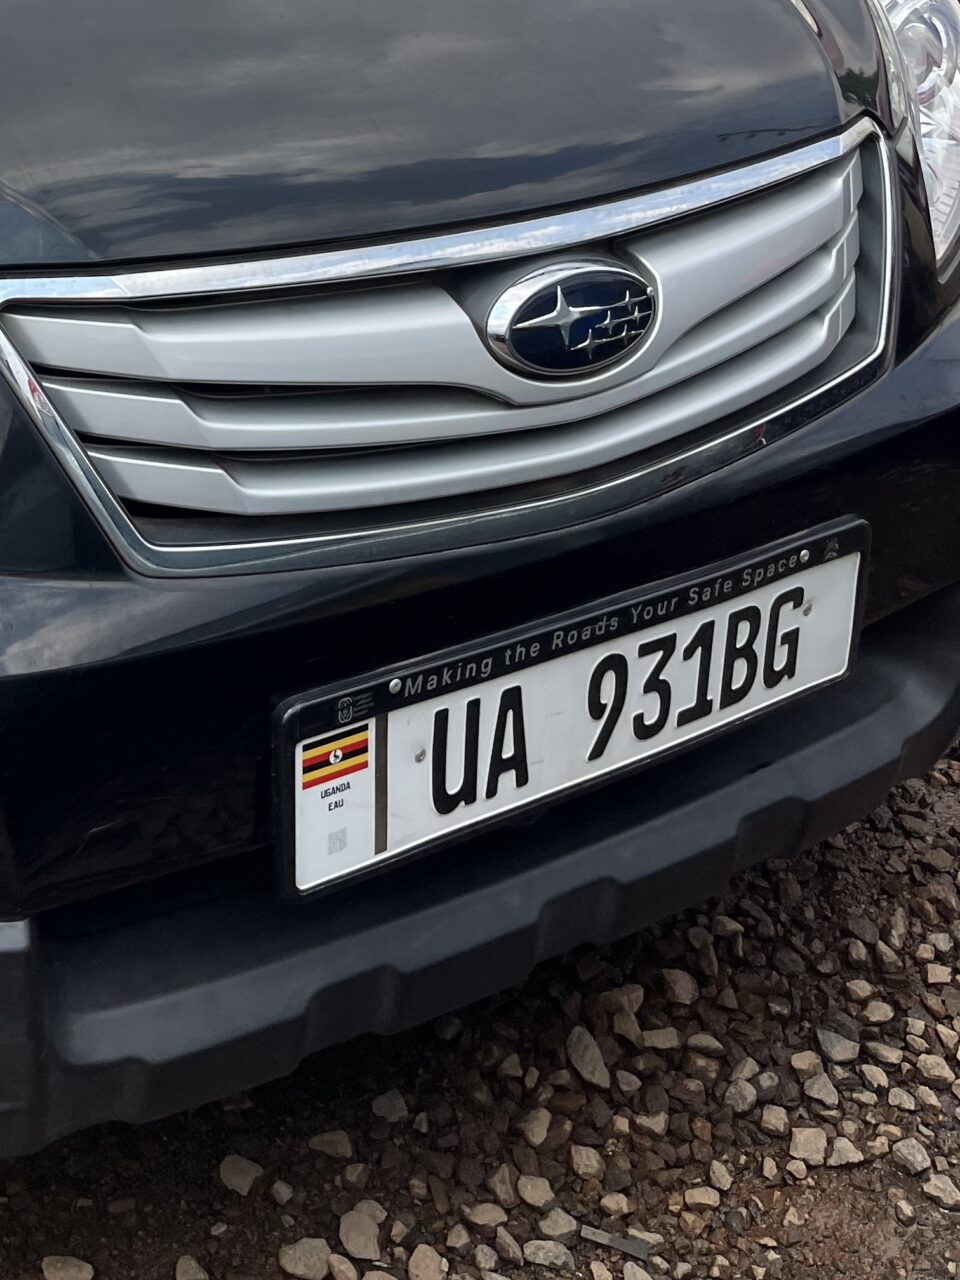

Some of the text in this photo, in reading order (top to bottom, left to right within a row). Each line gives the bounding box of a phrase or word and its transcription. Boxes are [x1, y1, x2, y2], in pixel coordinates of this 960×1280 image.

[404, 552, 798, 697] Making the Roads Your Safe Space
[431, 586, 806, 815] UA 931BG
[320, 781, 351, 799] UGANDA
[328, 799, 344, 811] EAU
